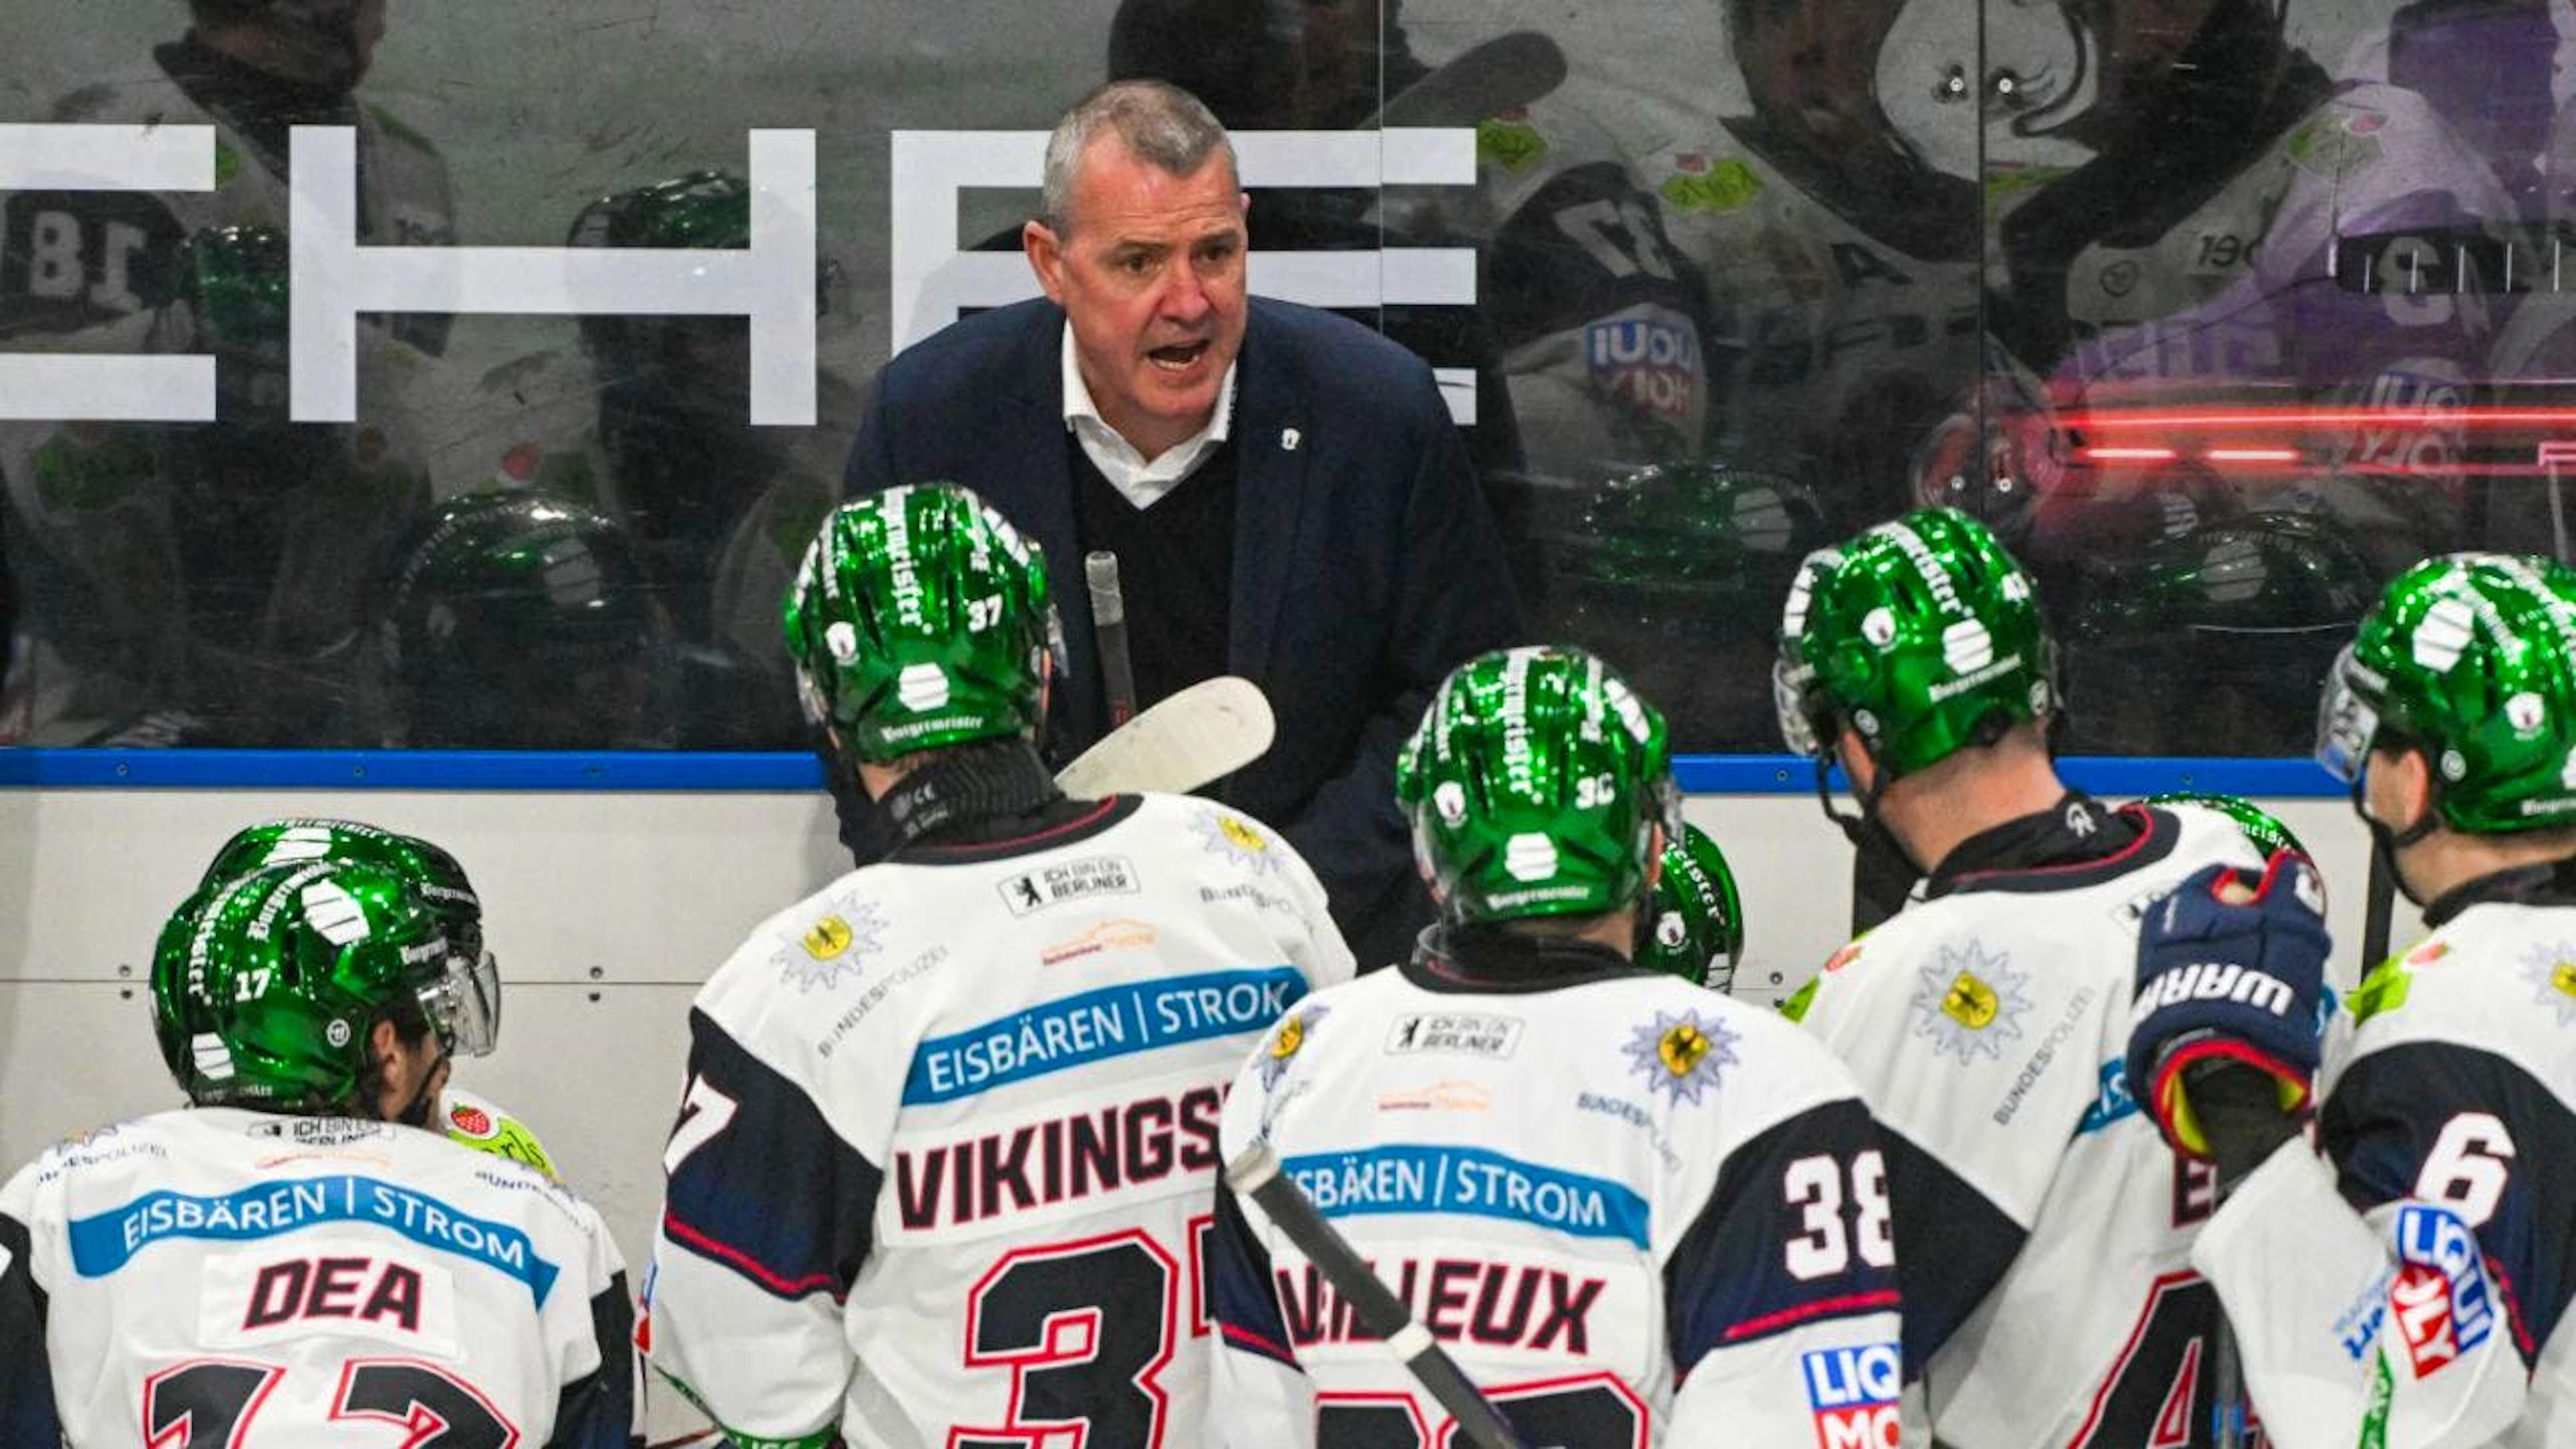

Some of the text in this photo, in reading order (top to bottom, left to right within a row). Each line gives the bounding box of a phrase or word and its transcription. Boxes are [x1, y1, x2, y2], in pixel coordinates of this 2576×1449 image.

[967, 593, 1004, 633] 37
[235, 967, 271, 1002] 17
[927, 1002, 1126, 1093] EISBÄREN
[896, 1081, 1229, 1230] VIKINGS
[1455, 1158, 1606, 1228] STROM
[2416, 1112, 2518, 1228] 6
[123, 1181, 327, 1252] EISBÄREN
[374, 1185, 525, 1271] STROM
[1784, 1148, 1898, 1280] 38
[241, 1256, 425, 1333] DEA
